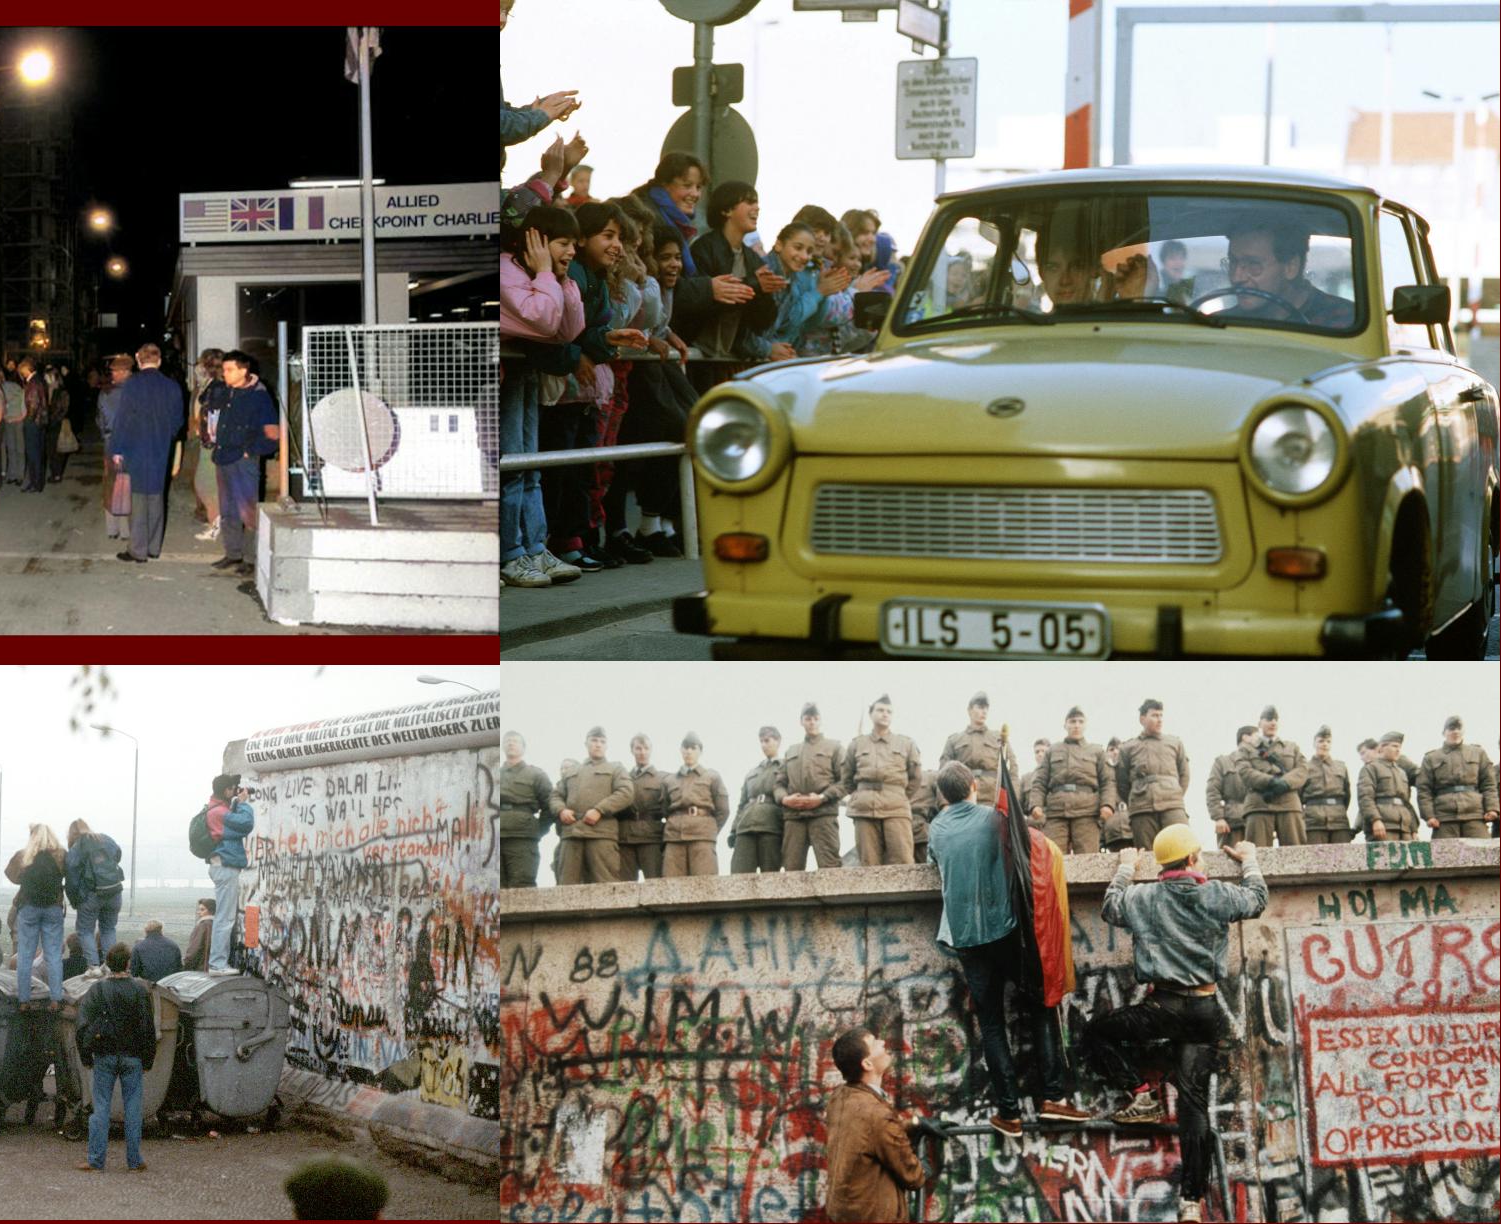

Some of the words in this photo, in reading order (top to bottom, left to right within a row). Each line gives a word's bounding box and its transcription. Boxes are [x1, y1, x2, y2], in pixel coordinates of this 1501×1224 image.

[386, 194, 440, 209] ALLIED
[329, 214, 427, 230] CHEKPOINT
[433, 211, 500, 226] CHARLIE
[903, 606, 959, 648] ILS
[990, 612, 1086, 651] 5-05
[263, 735, 284, 748] WELT
[283, 731, 304, 745] OHNE
[341, 723, 351, 737] ES
[353, 720, 373, 734] GILT
[374, 718, 391, 731] DIE
[371, 732, 392, 747] DES
[470, 718, 486, 732] ZU
[285, 776, 313, 799] LIVE
[326, 772, 368, 798] DALAI
[570, 946, 619, 983] 88
[1317, 1026, 1400, 1051] ESSEX
[1315, 1071, 1374, 1099] ALL
[1384, 1067, 1488, 1091] FORMS
